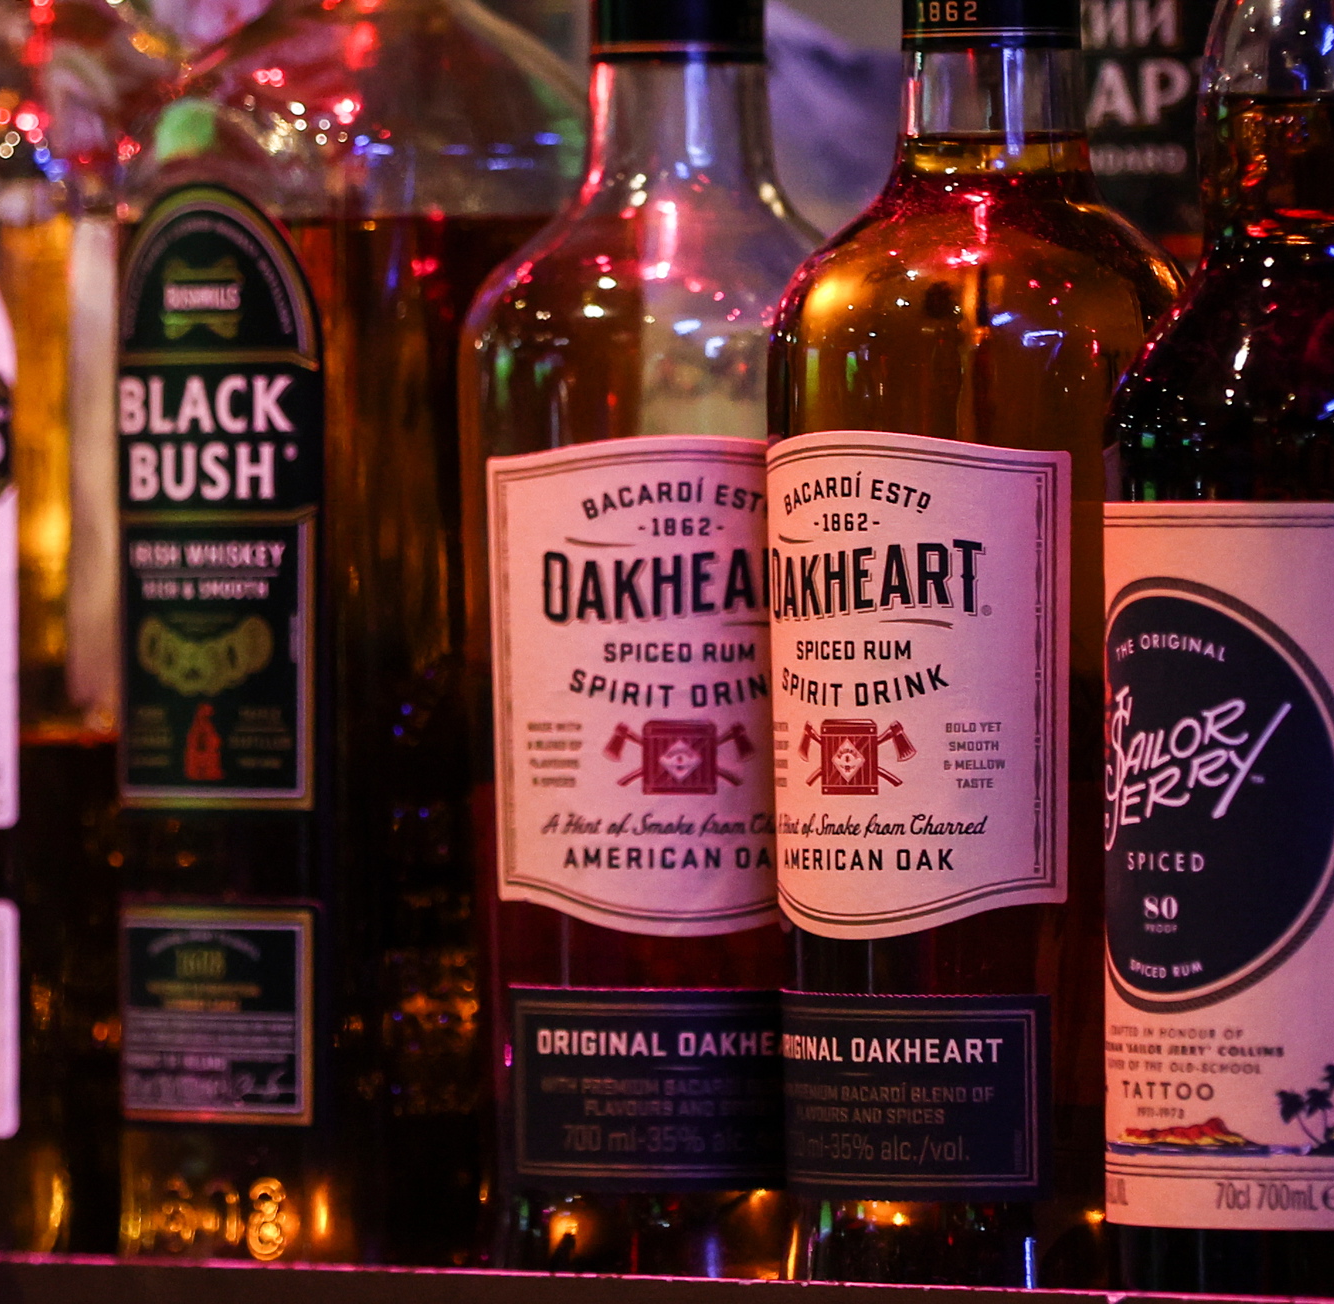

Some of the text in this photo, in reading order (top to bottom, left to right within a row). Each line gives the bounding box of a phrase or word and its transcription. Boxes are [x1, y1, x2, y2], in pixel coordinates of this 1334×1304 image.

[918, 1, 978, 23] 1862
[118, 374, 296, 435] BLACK
[128, 441, 277, 502] BUSH
[582, 477, 768, 519] BACARDÍ EST
[784, 471, 862, 515] BACARDÍ
[183, 540, 286, 568] WHISKEY
[543, 548, 770, 624] OAKHEA
[771, 539, 986, 620] OAKHEART
[603, 643, 756, 663] SPICED RUM
[796, 640, 912, 660] SPICED RUM
[1116, 633, 1227, 663] THE ORIGINAL
[569, 669, 769, 708] SPIRIT DRIN
[782, 664, 950, 707] SPIRIT DRINK
[945, 722, 1002, 733] BOLD YET
[949, 741, 1000, 752] SMOOTH
[1104, 685, 1250, 802] SAILOR
[943, 759, 1006, 771] & MELLOW
[1104, 703, 1293, 852] JERRY
[956, 778, 995, 789] TASTE
[561, 812, 601, 835] Hint
[607, 813, 628, 837] of
[633, 812, 695, 835] Smoke
[699, 813, 746, 838] from
[816, 813, 862, 836] Smoke
[864, 813, 906, 838] from
[910, 813, 988, 835] Charred
[563, 848, 772, 869] AMERICAN OA
[784, 848, 955, 871] AMERICAN OAK
[1127, 850, 1206, 872] SPICED
[1143, 895, 1180, 920] 80
[1129, 958, 1204, 979] SPICED RUM
[536, 1028, 779, 1057] ORIGINAL OAKHE
[1143, 1027, 1154, 1038] IN
[1159, 1028, 1216, 1040] HONOUR
[1223, 1029, 1244, 1040] OF
[781, 1033, 1004, 1063] RIGINAL OAKHEART
[1217, 1046, 1286, 1058] COLLINS
[1145, 1061, 1164, 1073] THE
[1169, 1062, 1261, 1075] OLD-SCHOOL
[842, 1082, 907, 1102] BACARDÍ
[910, 1086, 967, 1103] BLEND
[971, 1086, 996, 1103] OF
[1122, 1080, 1215, 1101] TATTOO
[852, 1108, 882, 1123] AND
[886, 1108, 946, 1124] SPICES
[563, 1124, 603, 1153] 700
[880, 1134, 971, 1165] alc./vol.
[1216, 1182, 1251, 1210] 70cl
